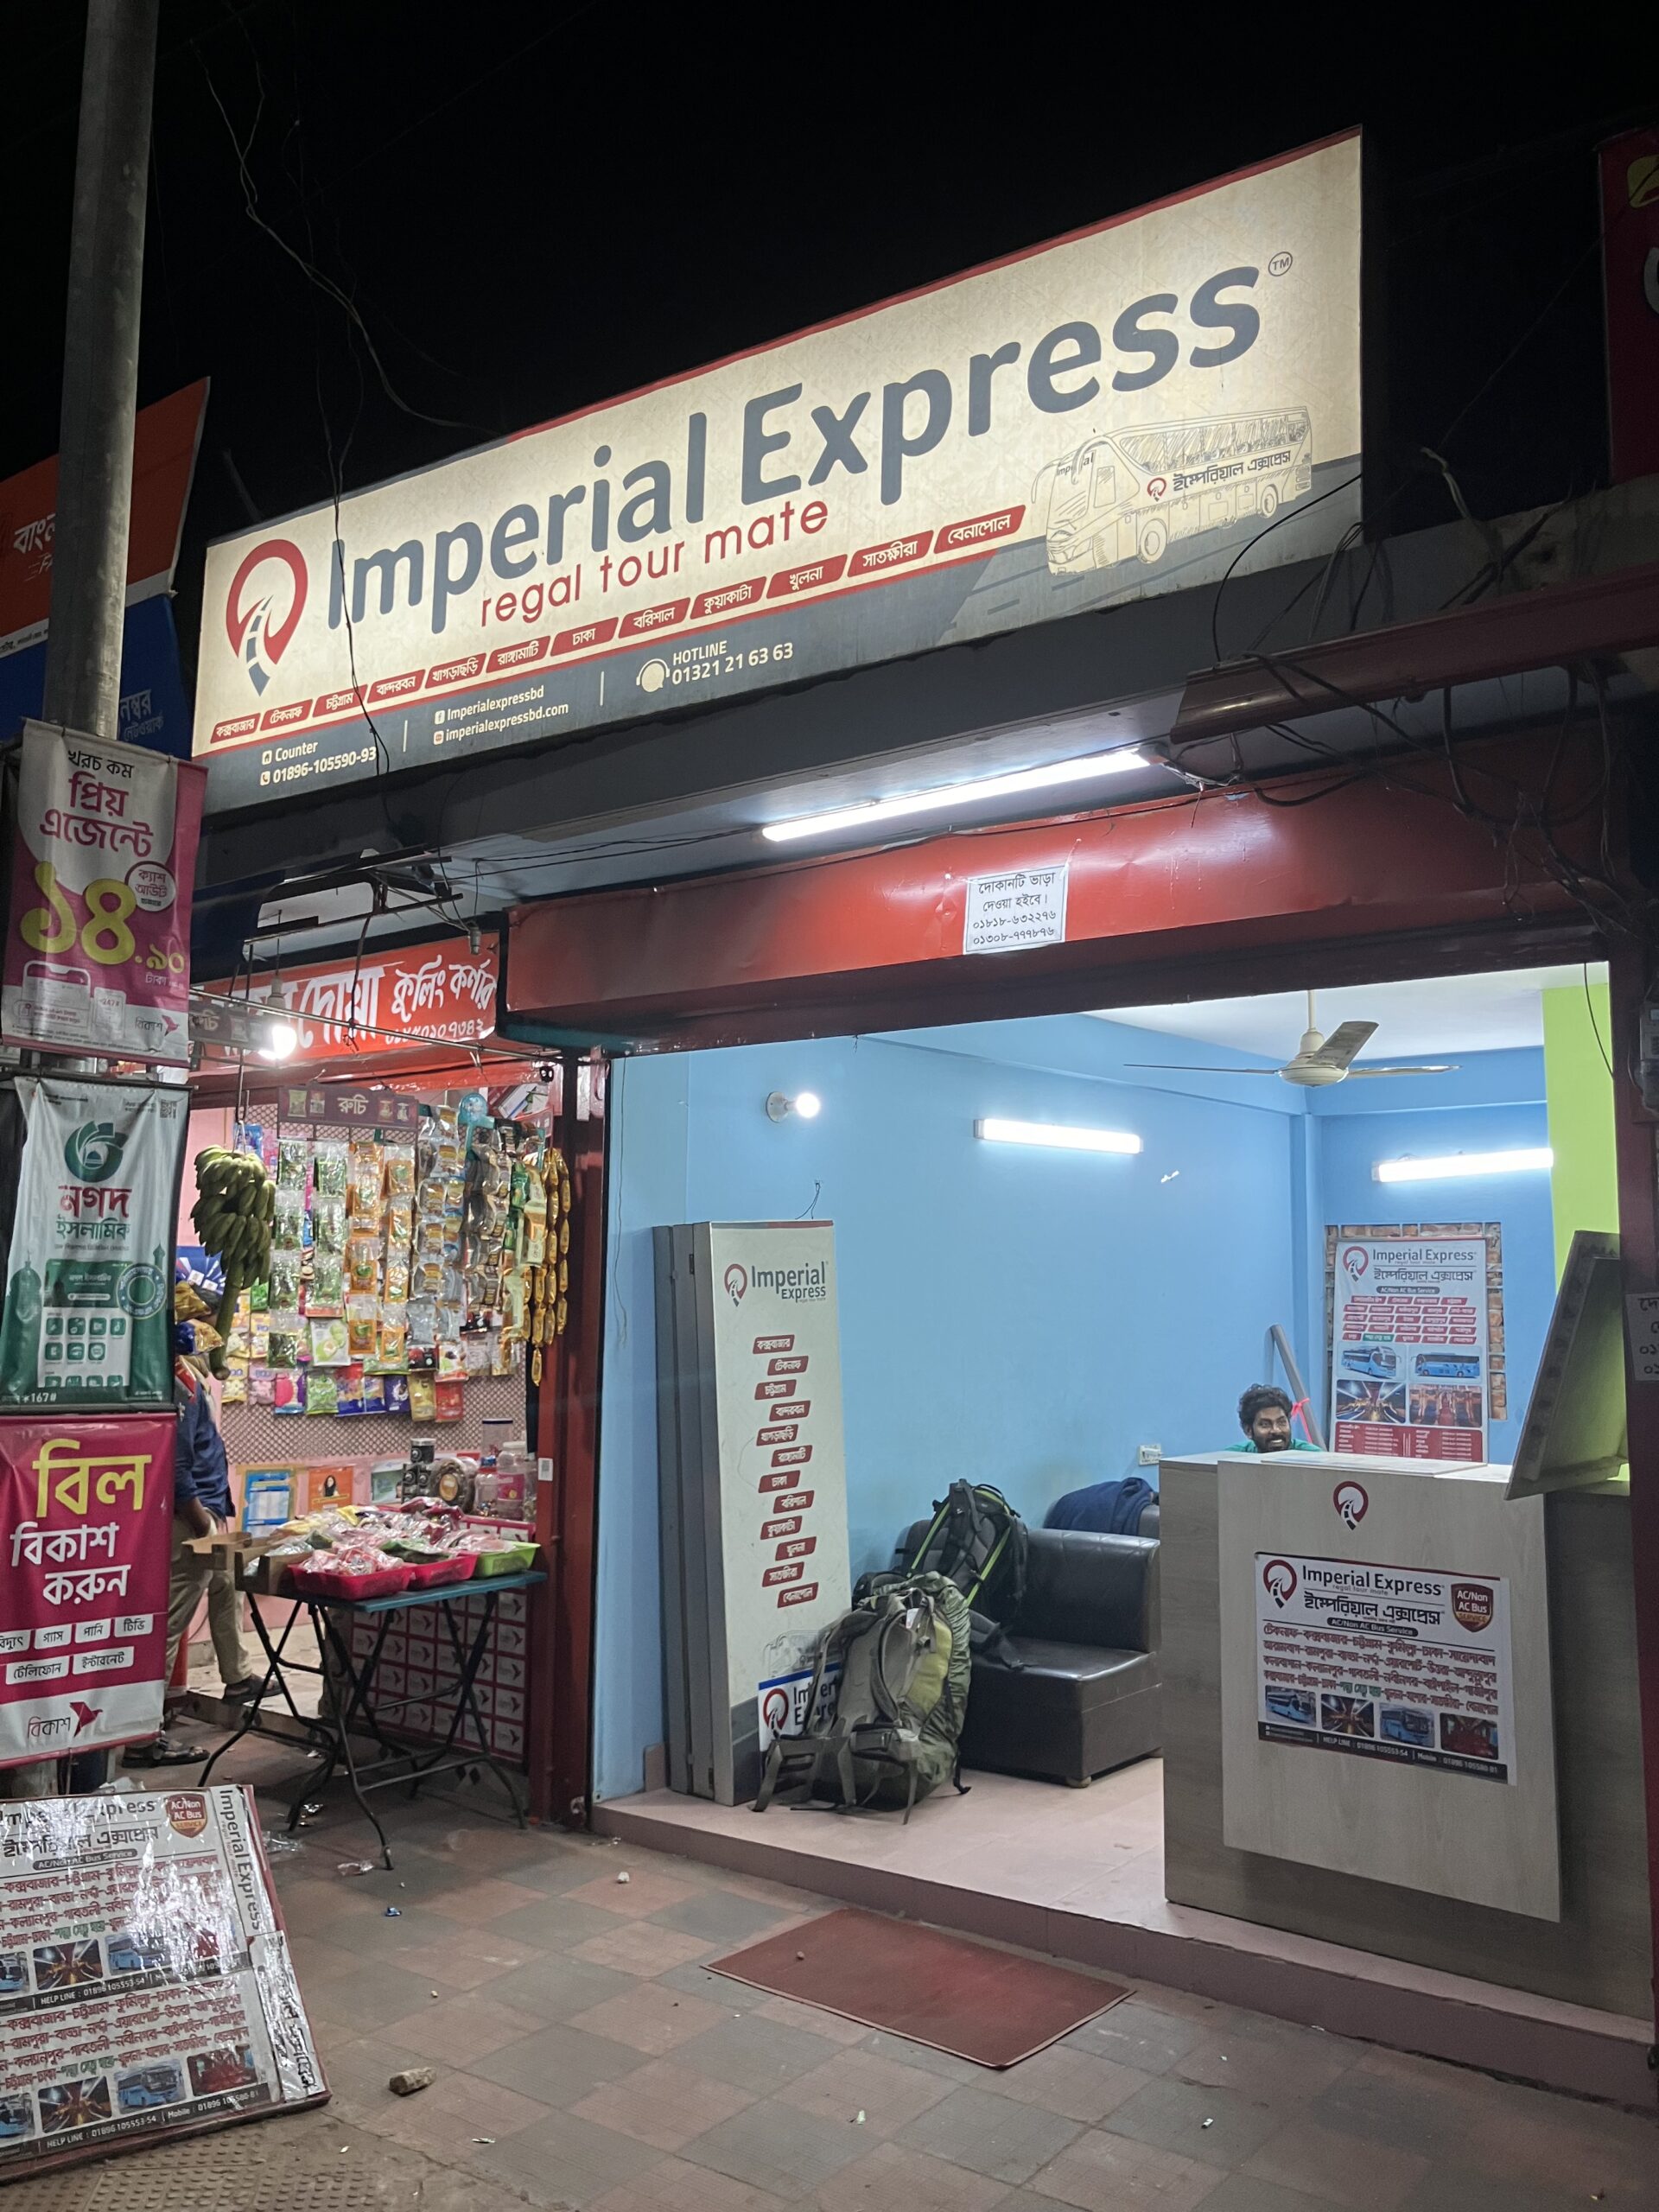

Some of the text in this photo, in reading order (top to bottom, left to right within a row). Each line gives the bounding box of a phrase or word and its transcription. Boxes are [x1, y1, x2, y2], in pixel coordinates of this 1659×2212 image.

[327, 410, 707, 634] Imperial
[741, 266, 1261, 505] Express
[1172, 449, 1292, 493] ইম্পেরিয়াল এক্সপ্রেস
[481, 500, 829, 627] regal tour mate
[216, 716, 255, 738] কক্সবাজার
[270, 706, 302, 724] টেকনাফ
[326, 692, 354, 710] চট্টগ্রাম
[432, 658, 479, 683] খাগড়াছড়ি
[497, 640, 540, 666] রাঙ্গামাটি
[572, 628, 595, 645] ঢাকা
[633, 605, 676, 629] বরিশাল
[704, 585, 752, 614] কুয়াকাটা
[789, 565, 823, 590] খুলনা
[862, 539, 918, 569] সাতক্ষীরা
[947, 514, 1011, 544] বেনাপোল
[671, 642, 794, 686] 01321 21 63 63
[672, 640, 728, 665] HOTLINE
[445, 702, 569, 741] imperialexpressbd.com
[275, 740, 319, 763] Counter
[67, 750, 134, 779] খরচ কম
[272, 747, 377, 784] 01896-105590-93
[68, 771, 129, 818] প্রিয়
[40, 808, 154, 858] এজেন্টে
[138, 869, 166, 885] ক্যাশ
[978, 872, 1056, 894] দোকানটি ভাড়া
[134, 881, 168, 899] আউট
[982, 898, 1011, 912] দেওয়া
[1015, 893, 1040, 907] হইবে
[973, 911, 1057, 930] ০১৮১৮-৬৩২২৭৬
[973, 926, 1055, 945] ০১৩০৮-৭৭৭৮৭৬
[145, 972, 168, 987] টাকা
[134, 1015, 163, 1033] বিকাশ
[338, 1095, 369, 1115] রুচি
[58, 1184, 132, 1220] নগদ
[55, 1214, 130, 1243] ইসলামিক
[1373, 1249, 1474, 1263] Imperial Express
[751, 1261, 825, 1294] Imperial
[1374, 1268, 1473, 1283] ইম্পেরিয়াল এক্সপ্রেস
[781, 1286, 826, 1303] Express
[32, 1438, 152, 1518] বিল
[10, 1522, 119, 1567] বিকাশ
[43, 1565, 131, 1605] করুন
[1302, 1565, 1441, 1596] Imperial Express
[1304, 1591, 1440, 1625] ইম্পেরিয়াল এক্সপ্রেস
[1457, 1590, 1488, 1603] AC/Non
[1459, 1602, 1487, 1614] AC Bus
[43, 1630, 64, 1643] গ্যাস
[84, 1623, 103, 1637] পানি
[124, 1618, 146, 1632] টিভি
[1331, 1618, 1357, 1629] AC/Non
[1359, 1622, 1370, 1630] AC
[1371, 1623, 1385, 1632] Bus
[1387, 1624, 1414, 1636] Service
[14, 1651, 124, 1679] টেলিফোন ইন্টারনেট
[28, 1716, 72, 1739] বিকাশ
[171, 1800, 200, 1809] AC/Non
[174, 1809, 202, 1820] AC Bus
[87, 1854, 101, 1864] Bus
[103, 1851, 133, 1861] Service
[219, 1789, 261, 1931] Imperial Express
[41, 1994, 59, 2005] HELP
[60, 1992, 76, 2002] LINE
[47, 2138, 67, 2149] HELP
[67, 2133, 84, 2145] LINE
[168, 2108, 190, 2119] Mobile
